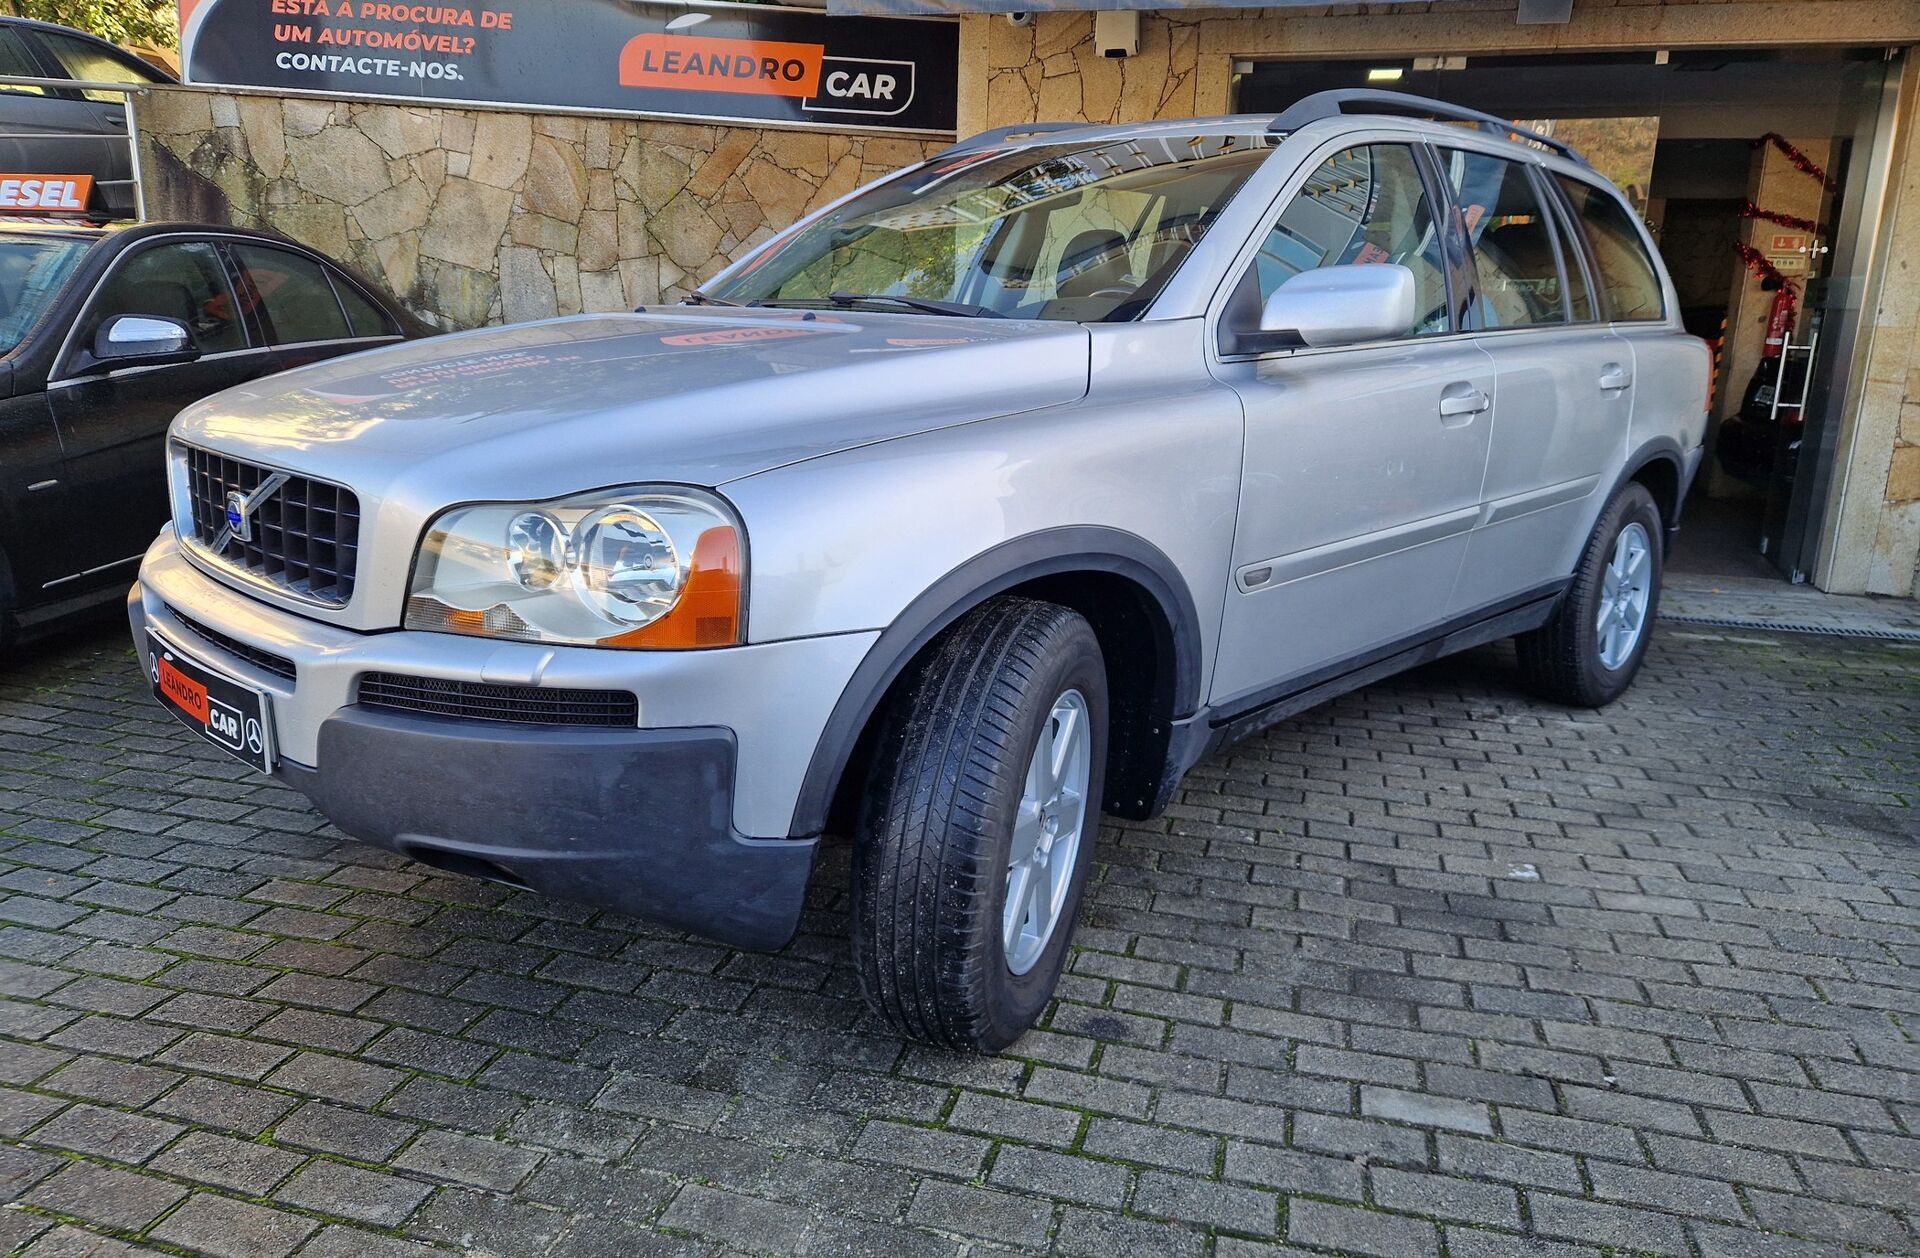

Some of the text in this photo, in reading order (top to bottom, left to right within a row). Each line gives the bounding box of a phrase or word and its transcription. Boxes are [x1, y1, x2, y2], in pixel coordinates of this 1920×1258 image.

[360, 3, 475, 27] PROCURA
[481, 11, 512, 30] DE
[274, 24, 476, 54] UM AUTOMÓVEL?
[276, 52, 464, 81] CONTACTE-NOS.
[642, 49, 896, 100] LEANDRO CAR
[162, 667, 238, 739] LEANDRO CAR
